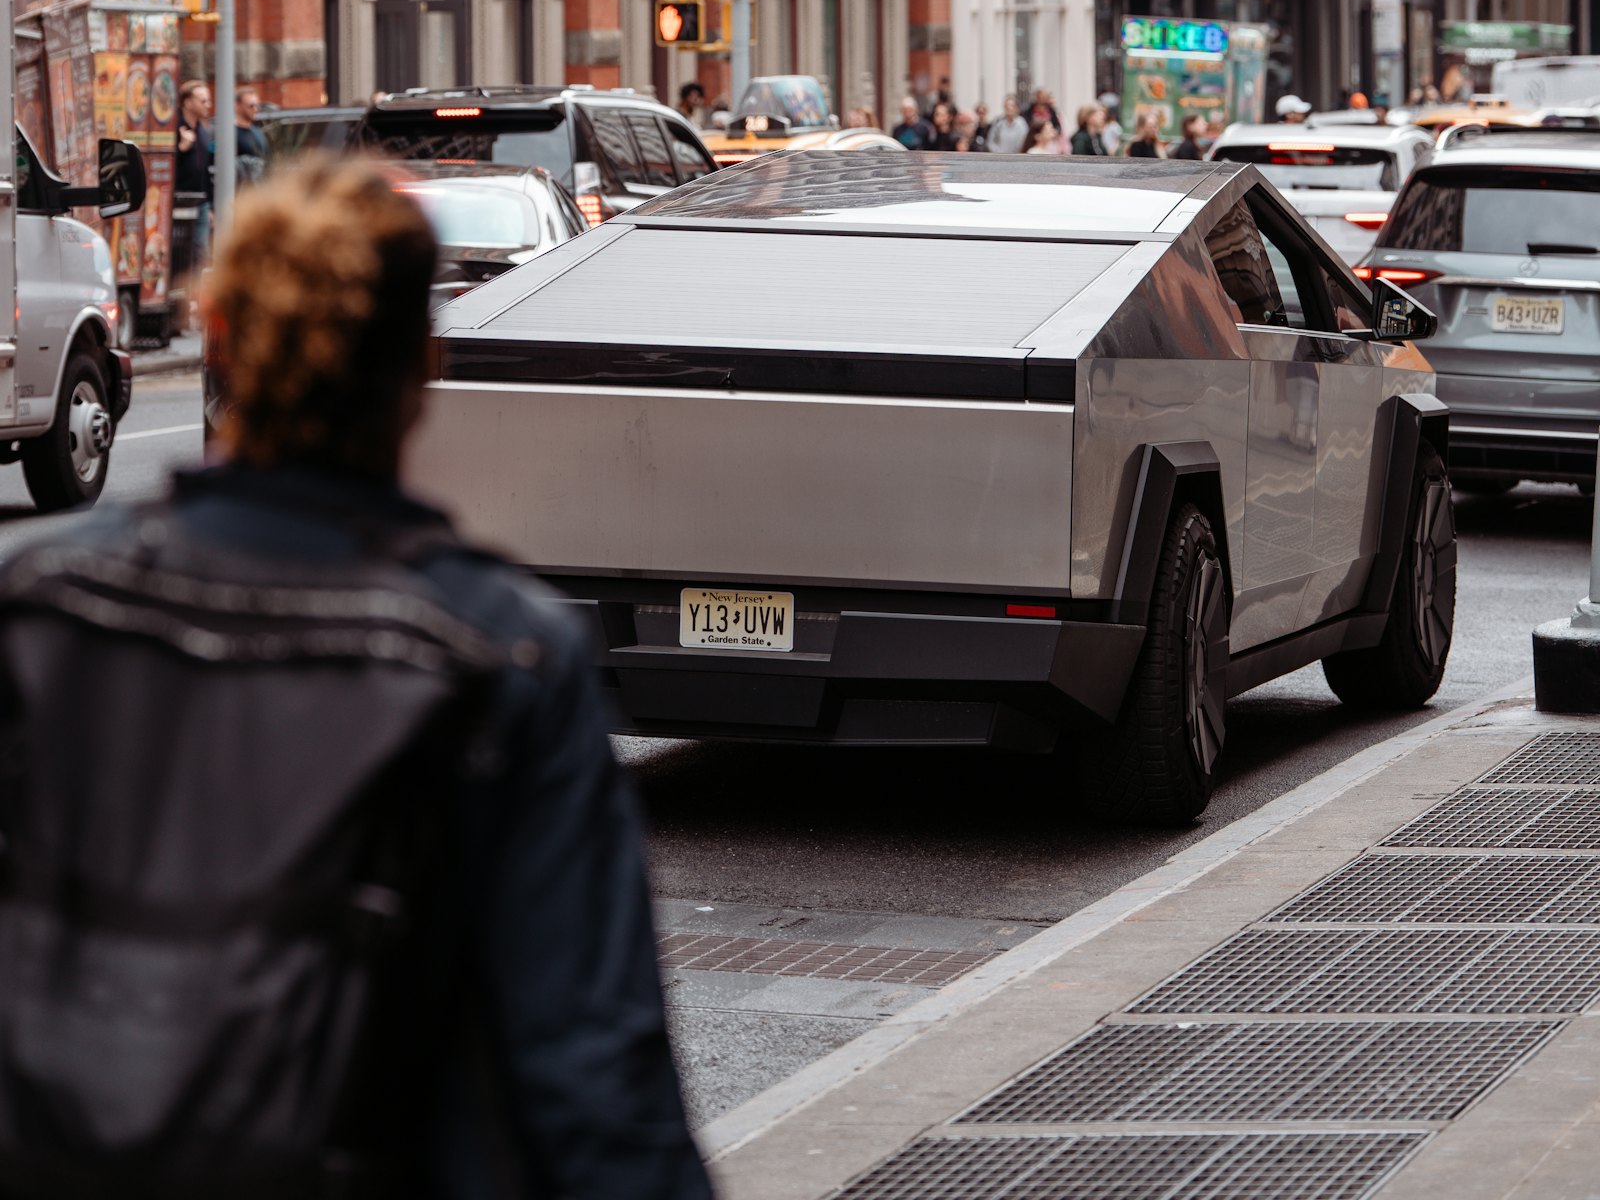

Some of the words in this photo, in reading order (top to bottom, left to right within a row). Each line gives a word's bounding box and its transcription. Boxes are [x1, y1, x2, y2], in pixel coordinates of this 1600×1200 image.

[708, 592, 732, 603] New
[733, 592, 765, 605] Jersey
[707, 635, 739, 644] Garden
[741, 636, 765, 645] State
